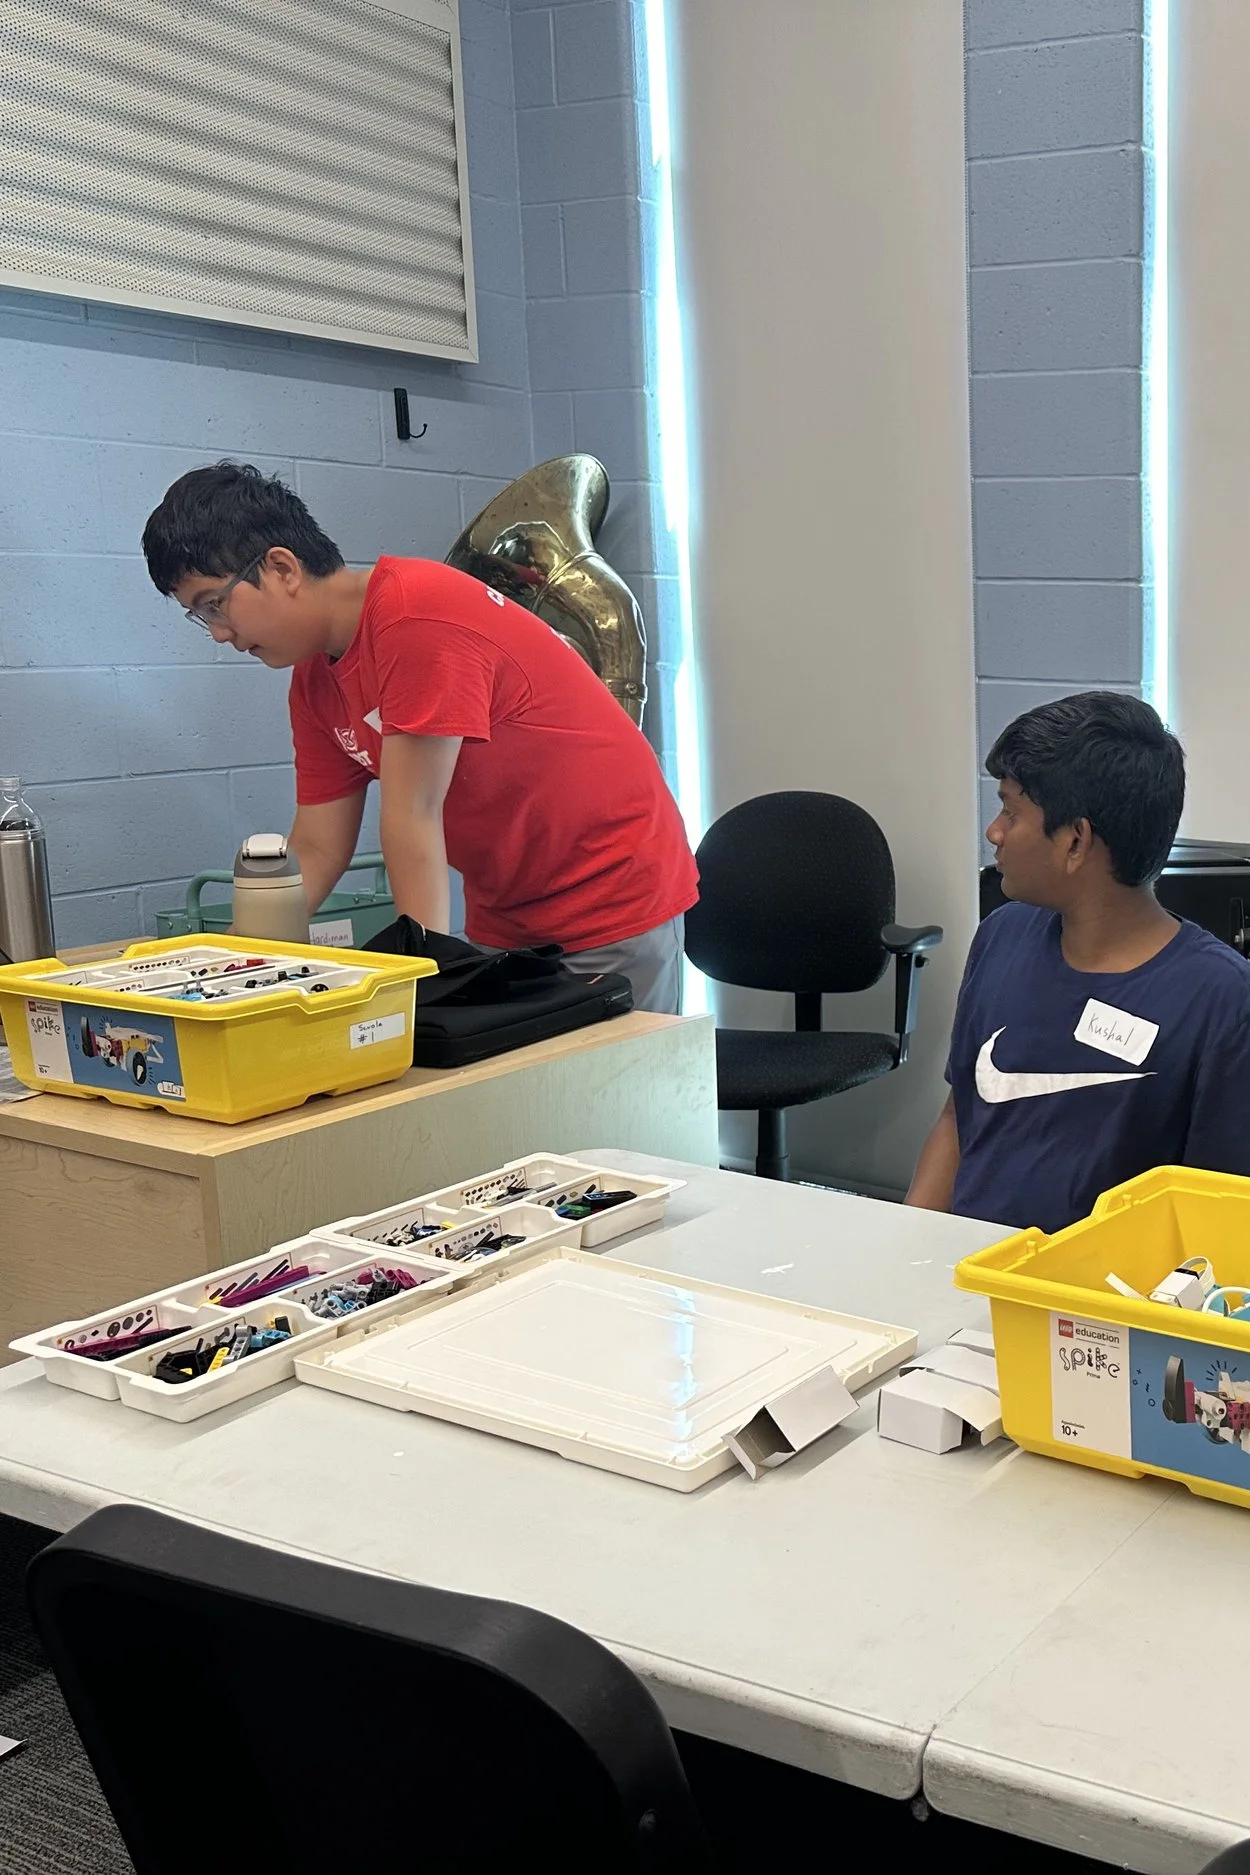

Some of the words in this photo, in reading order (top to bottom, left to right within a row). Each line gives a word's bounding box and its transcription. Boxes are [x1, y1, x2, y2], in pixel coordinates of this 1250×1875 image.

[1087, 1013, 1135, 1046] Kushal
[1075, 1327, 1120, 1344] education
[1059, 1346, 1120, 1378] spike
[1061, 1425, 1079, 1437] 10+
